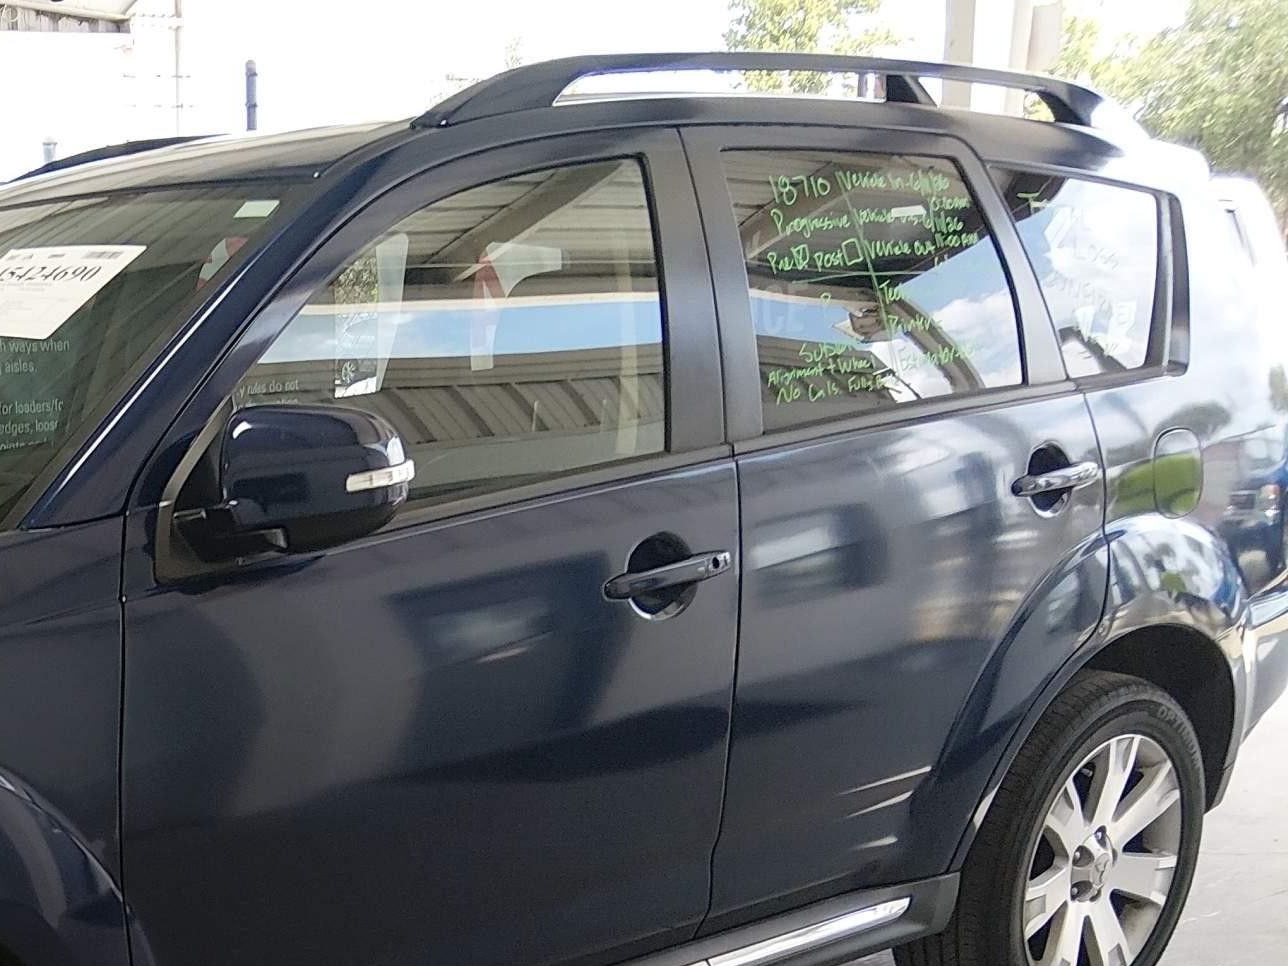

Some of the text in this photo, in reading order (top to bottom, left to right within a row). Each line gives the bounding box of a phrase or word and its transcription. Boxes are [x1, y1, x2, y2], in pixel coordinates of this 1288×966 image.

[769, 174, 831, 206] 18710
[770, 208, 851, 239] Progressive
[9, 341, 38, 355] ways
[40, 339, 70, 352] when
[5, 359, 38, 373] aisles.
[768, 362, 826, 387] Alignment
[247, 382, 266, 395] rules
[269, 380, 283, 393] do
[776, 384, 802, 407] No
